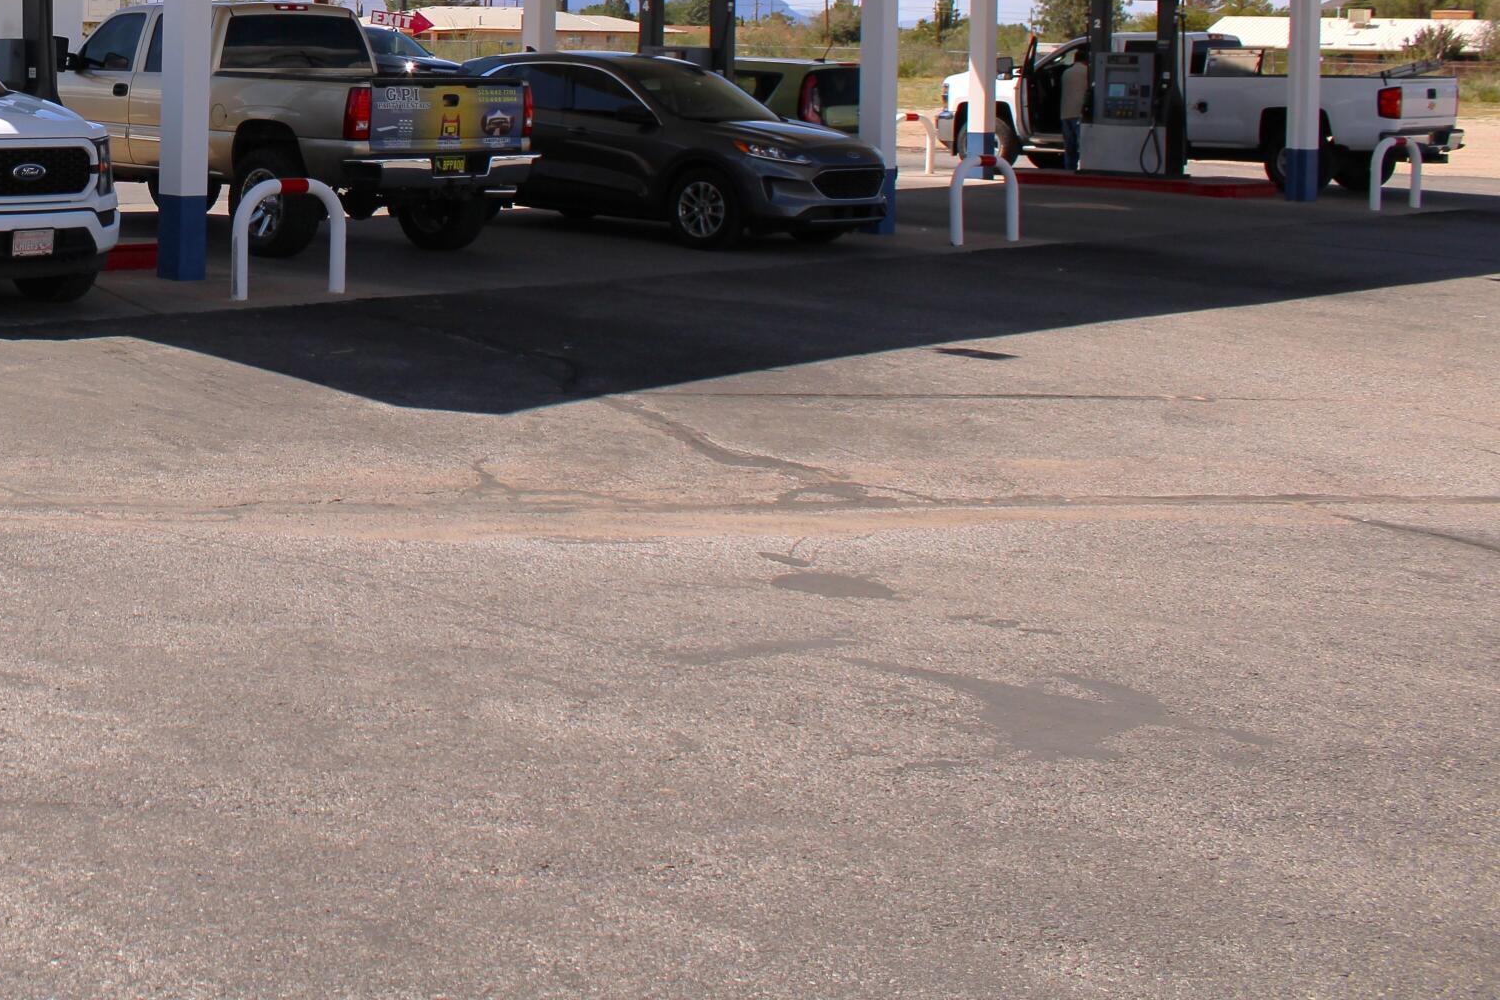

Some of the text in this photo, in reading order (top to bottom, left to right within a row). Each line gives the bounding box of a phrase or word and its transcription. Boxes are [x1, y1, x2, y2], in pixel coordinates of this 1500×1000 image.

[642, 0, 650, 11] 4
[373, 12, 413, 28] EXIT
[1094, 19, 1101, 28] 2
[385, 87, 420, 101] G.P.I
[21, 167, 39, 176] Ford
